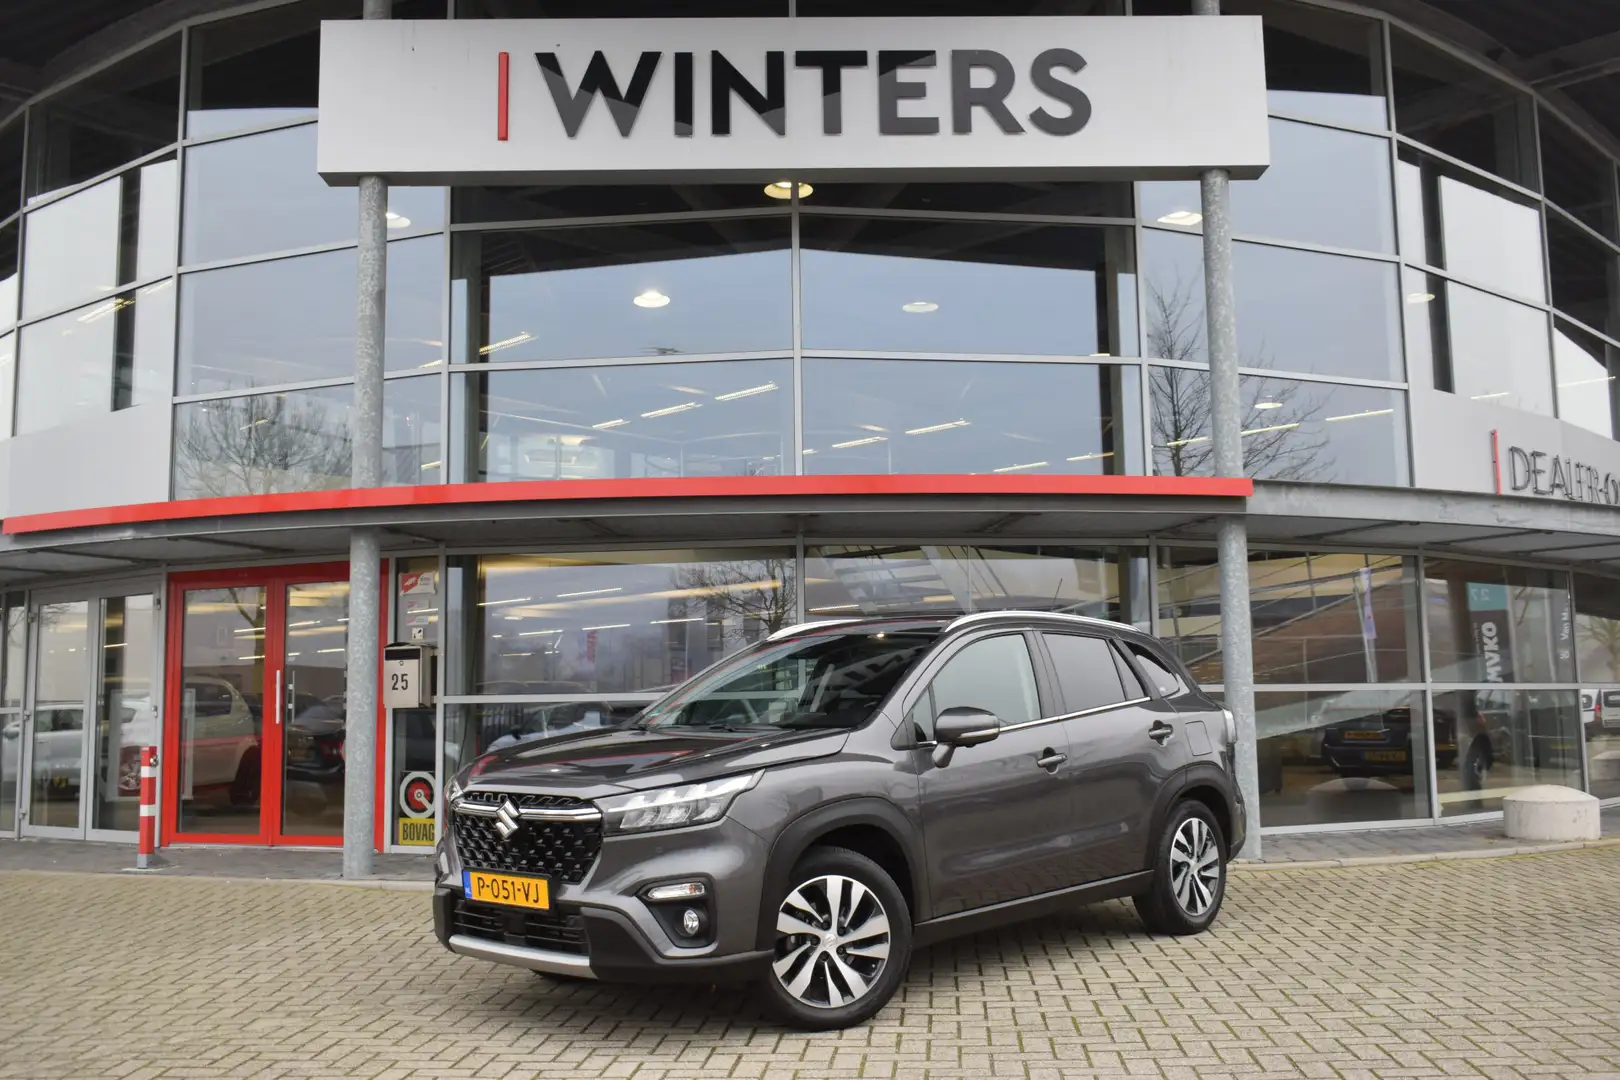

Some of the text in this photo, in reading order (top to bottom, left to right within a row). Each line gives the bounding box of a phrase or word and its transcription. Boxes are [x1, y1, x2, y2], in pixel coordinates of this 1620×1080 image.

[534, 48, 1092, 139] WINTERS
[391, 673, 409, 691] 25
[402, 823, 435, 842] BOVAG
[477, 876, 540, 904] P-051-VJ
